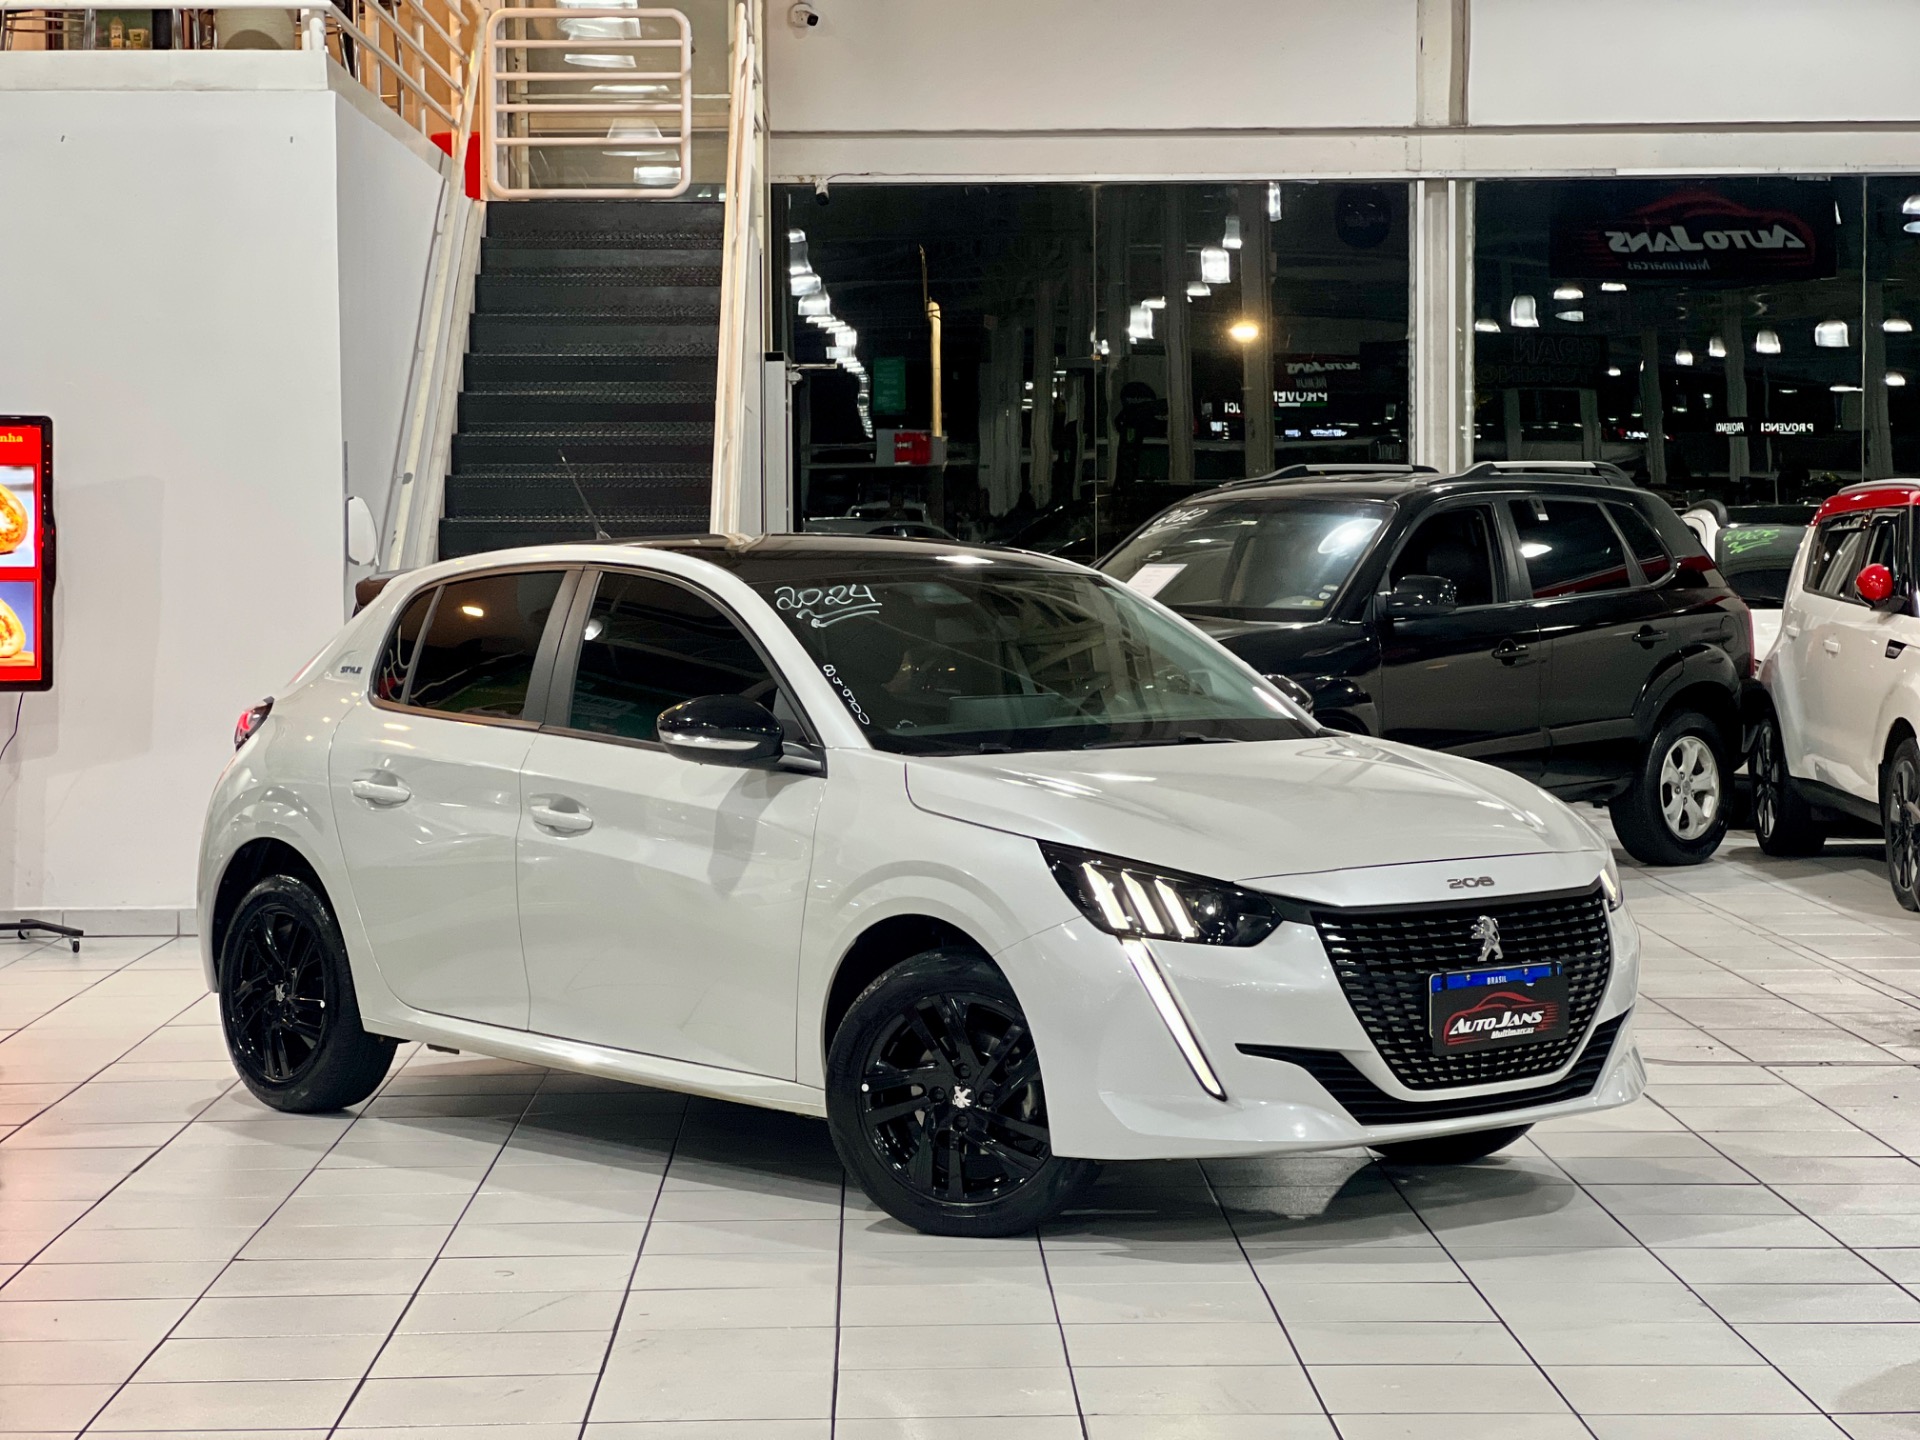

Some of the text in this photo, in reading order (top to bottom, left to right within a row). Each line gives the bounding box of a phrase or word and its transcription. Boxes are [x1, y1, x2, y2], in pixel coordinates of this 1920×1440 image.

[774, 584, 876, 610] 2024
[341, 666, 362, 674] STYLE
[1447, 876, 1495, 889] 208
[1486, 975, 1508, 985] BRASIL
[1491, 1027, 1535, 1039] Multimarcas
